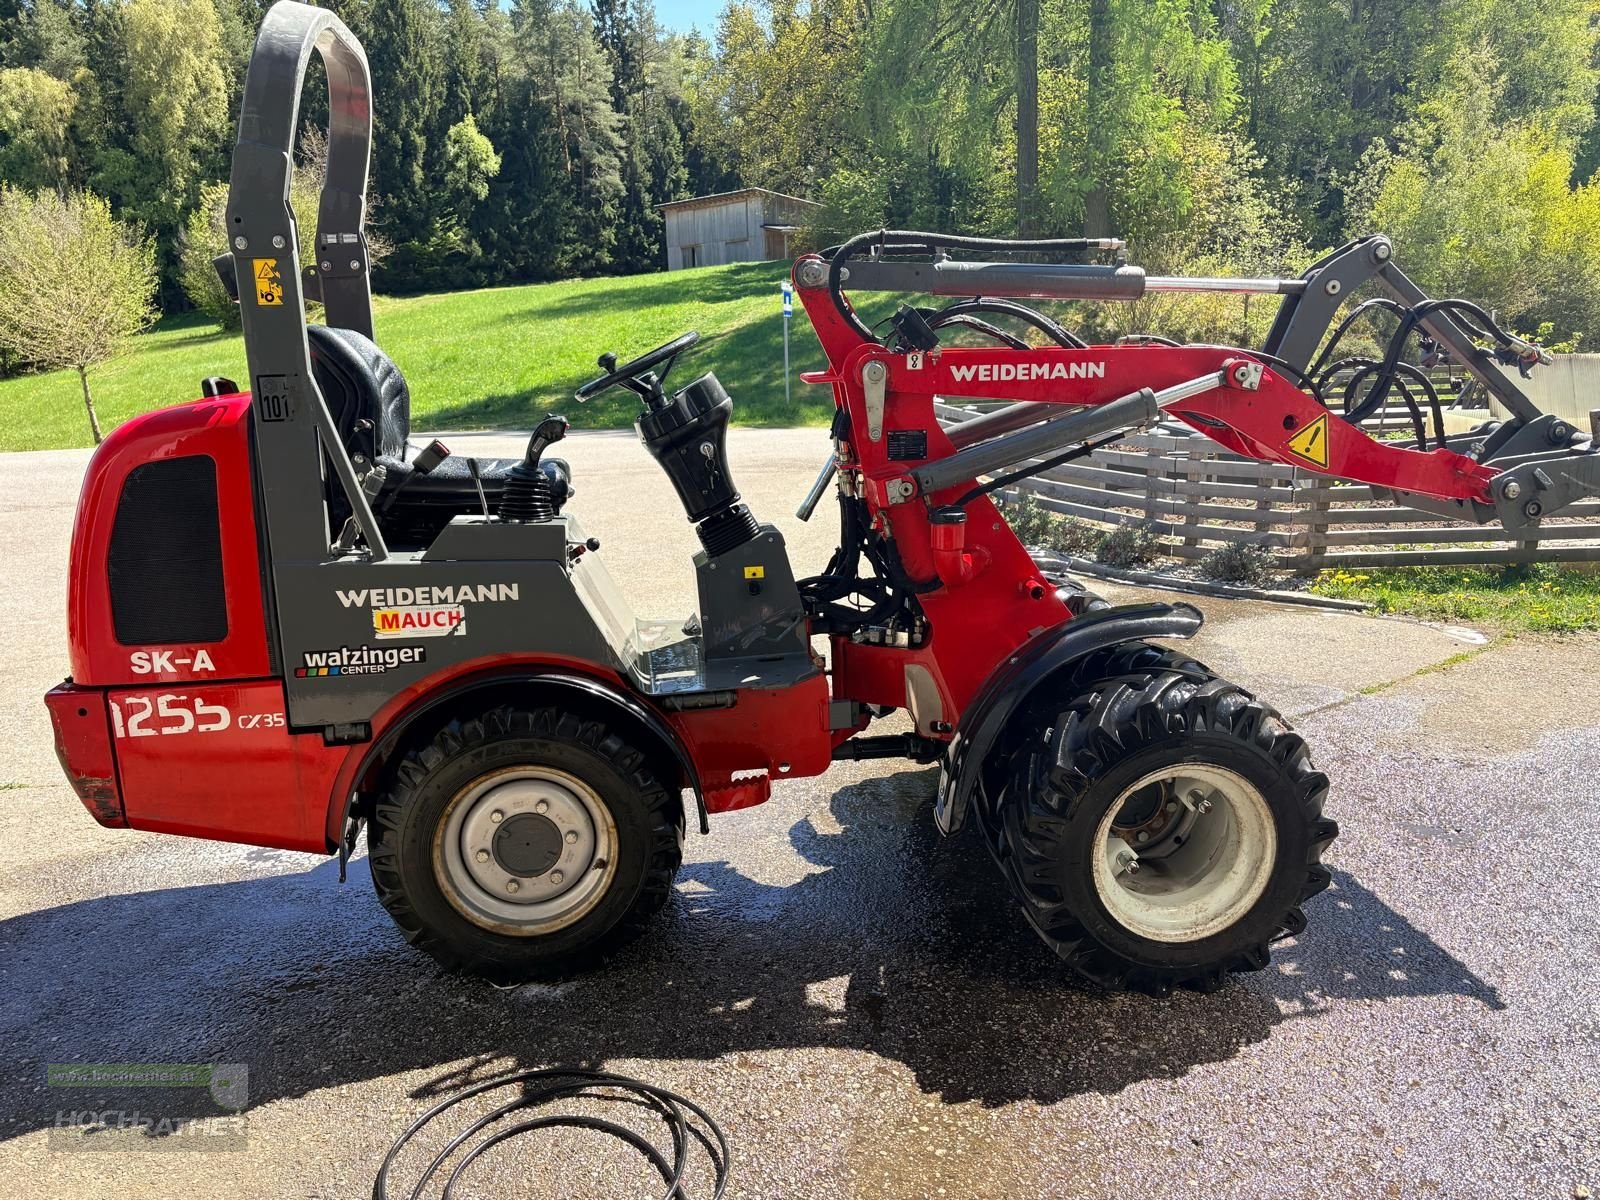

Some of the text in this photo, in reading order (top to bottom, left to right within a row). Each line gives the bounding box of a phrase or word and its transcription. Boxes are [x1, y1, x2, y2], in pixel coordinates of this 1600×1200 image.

[951, 361, 1105, 382] WEIDEMANN
[336, 583, 519, 608] WEIDEMANN
[381, 611, 461, 630] MAUCH
[130, 649, 216, 674] SK-A
[305, 646, 424, 667] watzinger
[340, 665, 385, 675] CENTER
[109, 695, 285, 738] 1255 CX35
